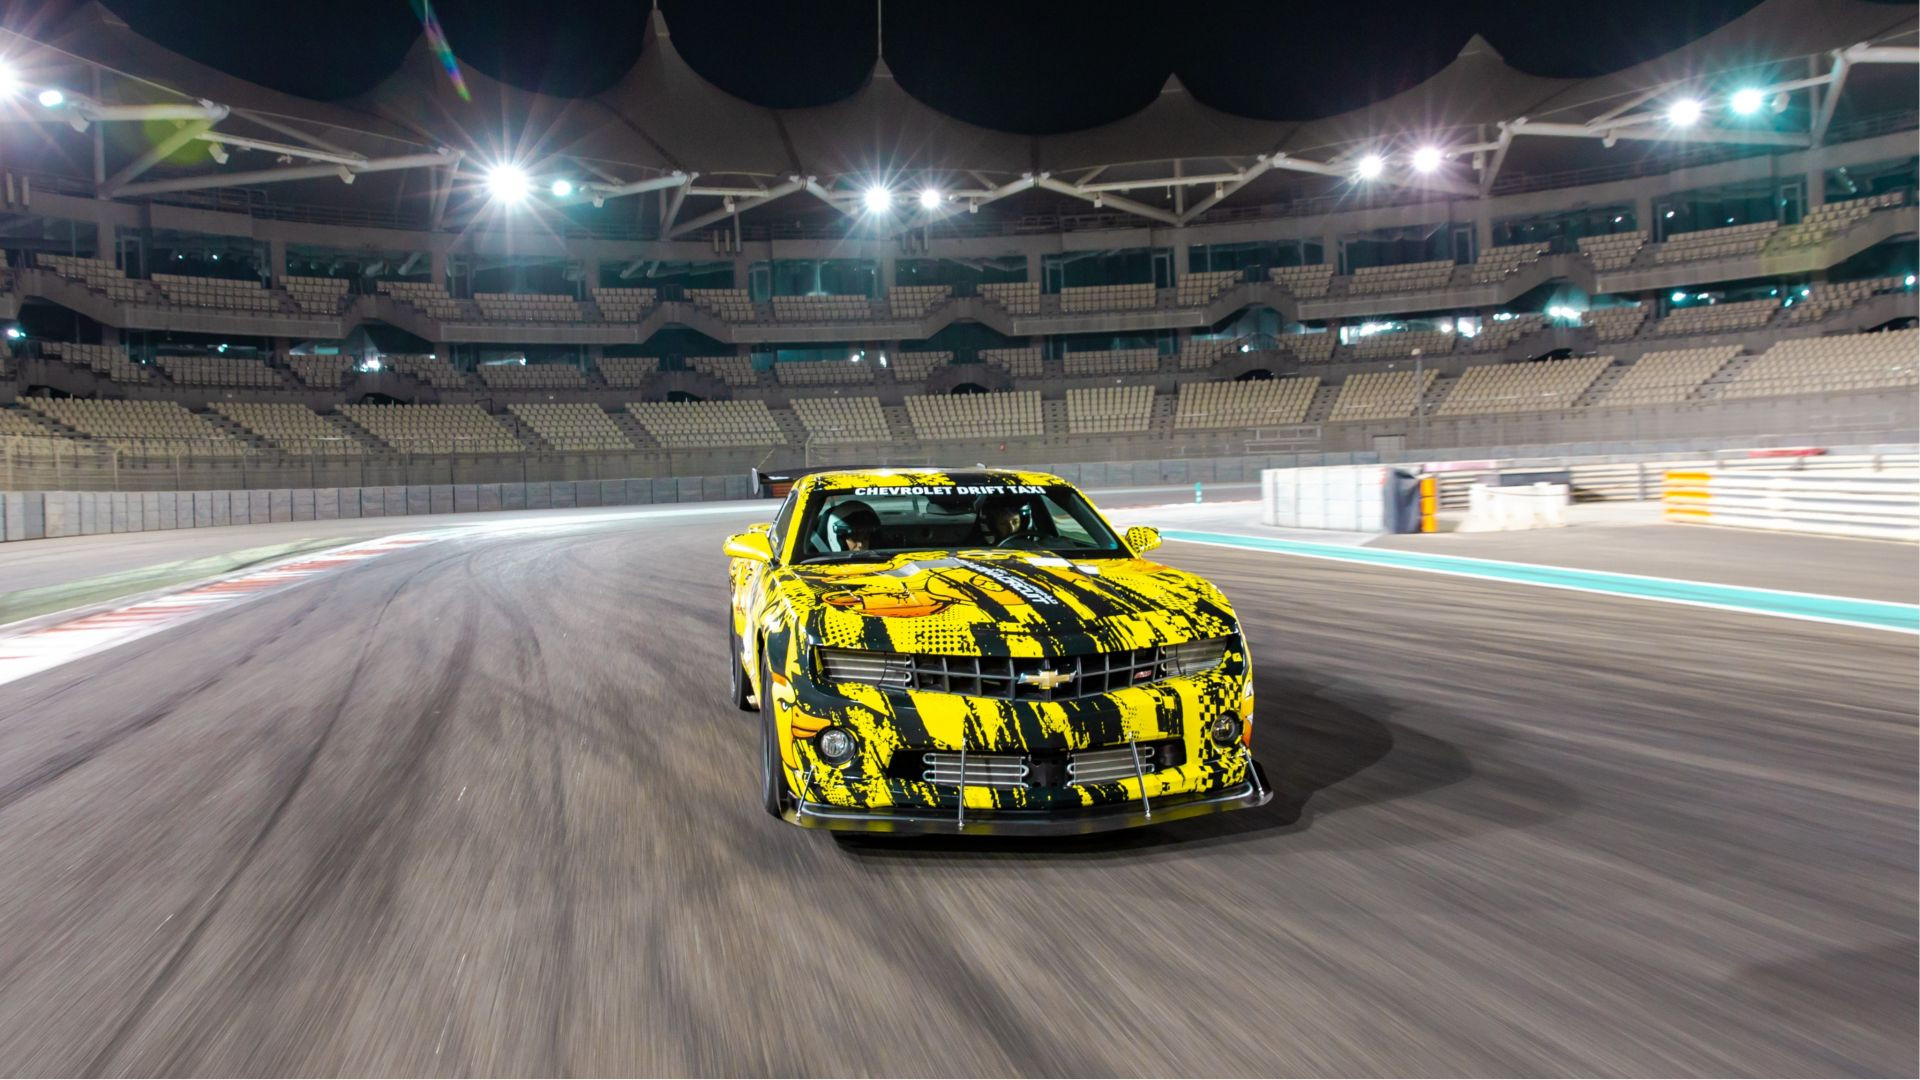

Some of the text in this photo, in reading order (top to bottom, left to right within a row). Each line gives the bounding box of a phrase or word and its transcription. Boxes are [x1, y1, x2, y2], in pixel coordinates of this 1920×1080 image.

[854, 486, 1047, 496] CHEVROLET DRIFT TAXI
